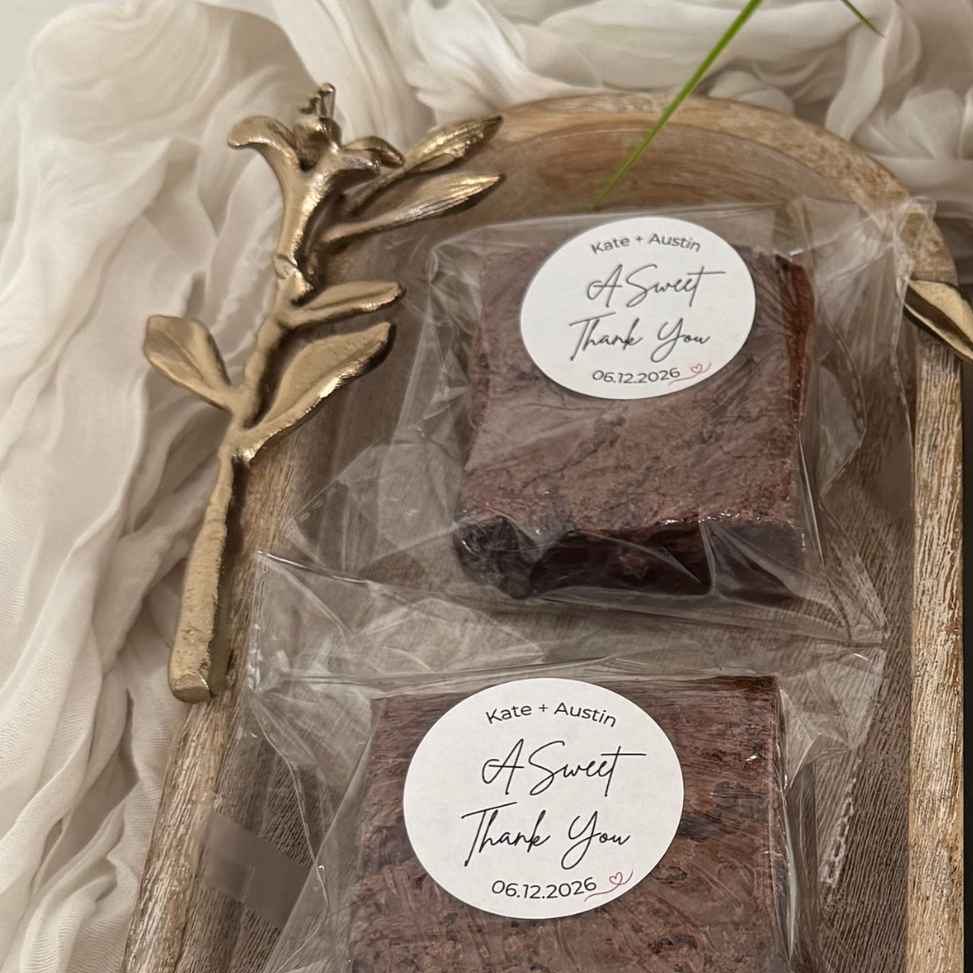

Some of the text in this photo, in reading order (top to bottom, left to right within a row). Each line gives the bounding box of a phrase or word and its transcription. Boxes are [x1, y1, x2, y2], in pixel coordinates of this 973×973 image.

[590, 236, 631, 255] Kate
[648, 233, 701, 253] Austin
[586, 264, 726, 308] A Sweet
[569, 312, 711, 364] Thank You
[592, 367, 681, 384] 06.12.2026
[485, 704, 533, 725] Kate
[554, 702, 617, 728] Austin
[481, 738, 647, 797] A Sweet
[461, 801, 631, 870] Thank You
[491, 877, 597, 899] 06.12.2026
